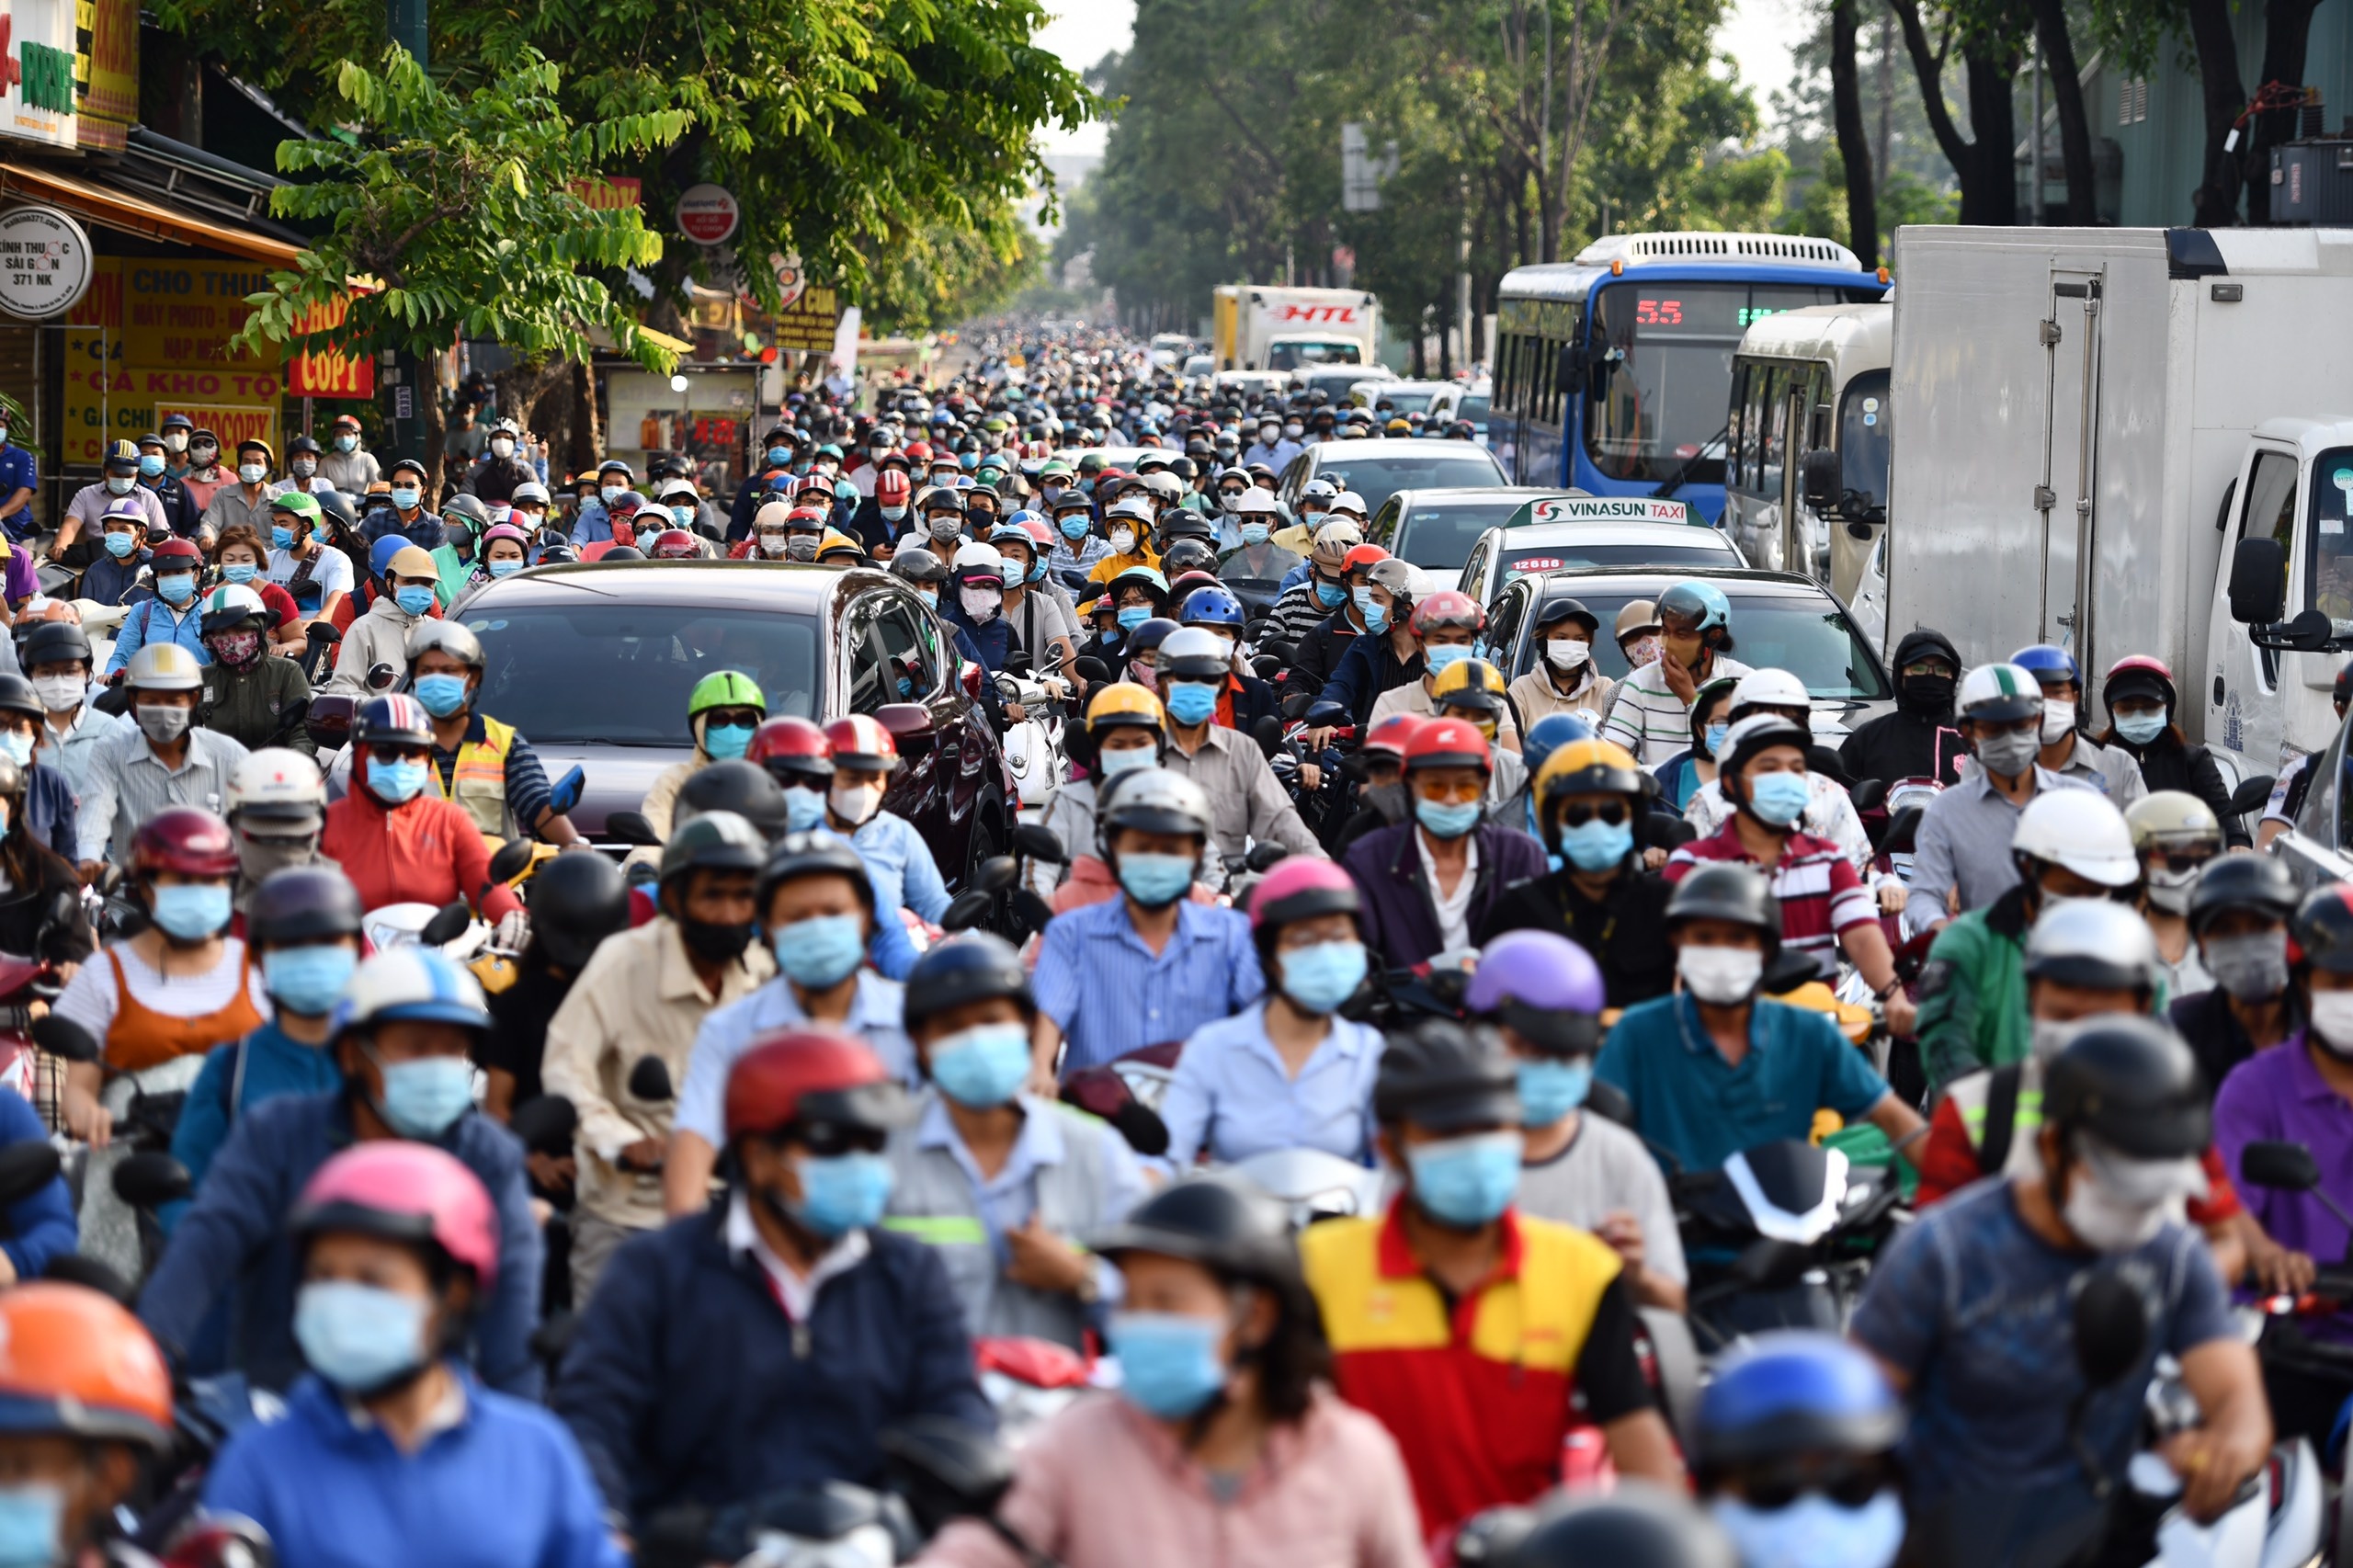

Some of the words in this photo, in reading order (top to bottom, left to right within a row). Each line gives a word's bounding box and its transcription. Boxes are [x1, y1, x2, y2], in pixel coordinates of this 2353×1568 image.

[6, 256, 24, 269] SÀI
[13, 274, 32, 286] 371
[37, 275, 52, 286] NK
[134, 268, 192, 294] CHO
[169, 304, 215, 328] PHOTO
[1285, 305, 1358, 324] HTL
[1636, 300, 1682, 324] 55
[301, 348, 360, 392] COPY
[147, 372, 221, 395] KHO
[232, 371, 278, 402] TỘ
[1569, 503, 1645, 517] VINASUN
[1651, 505, 1684, 519] TAXI
[1514, 559, 1560, 570] 12686
